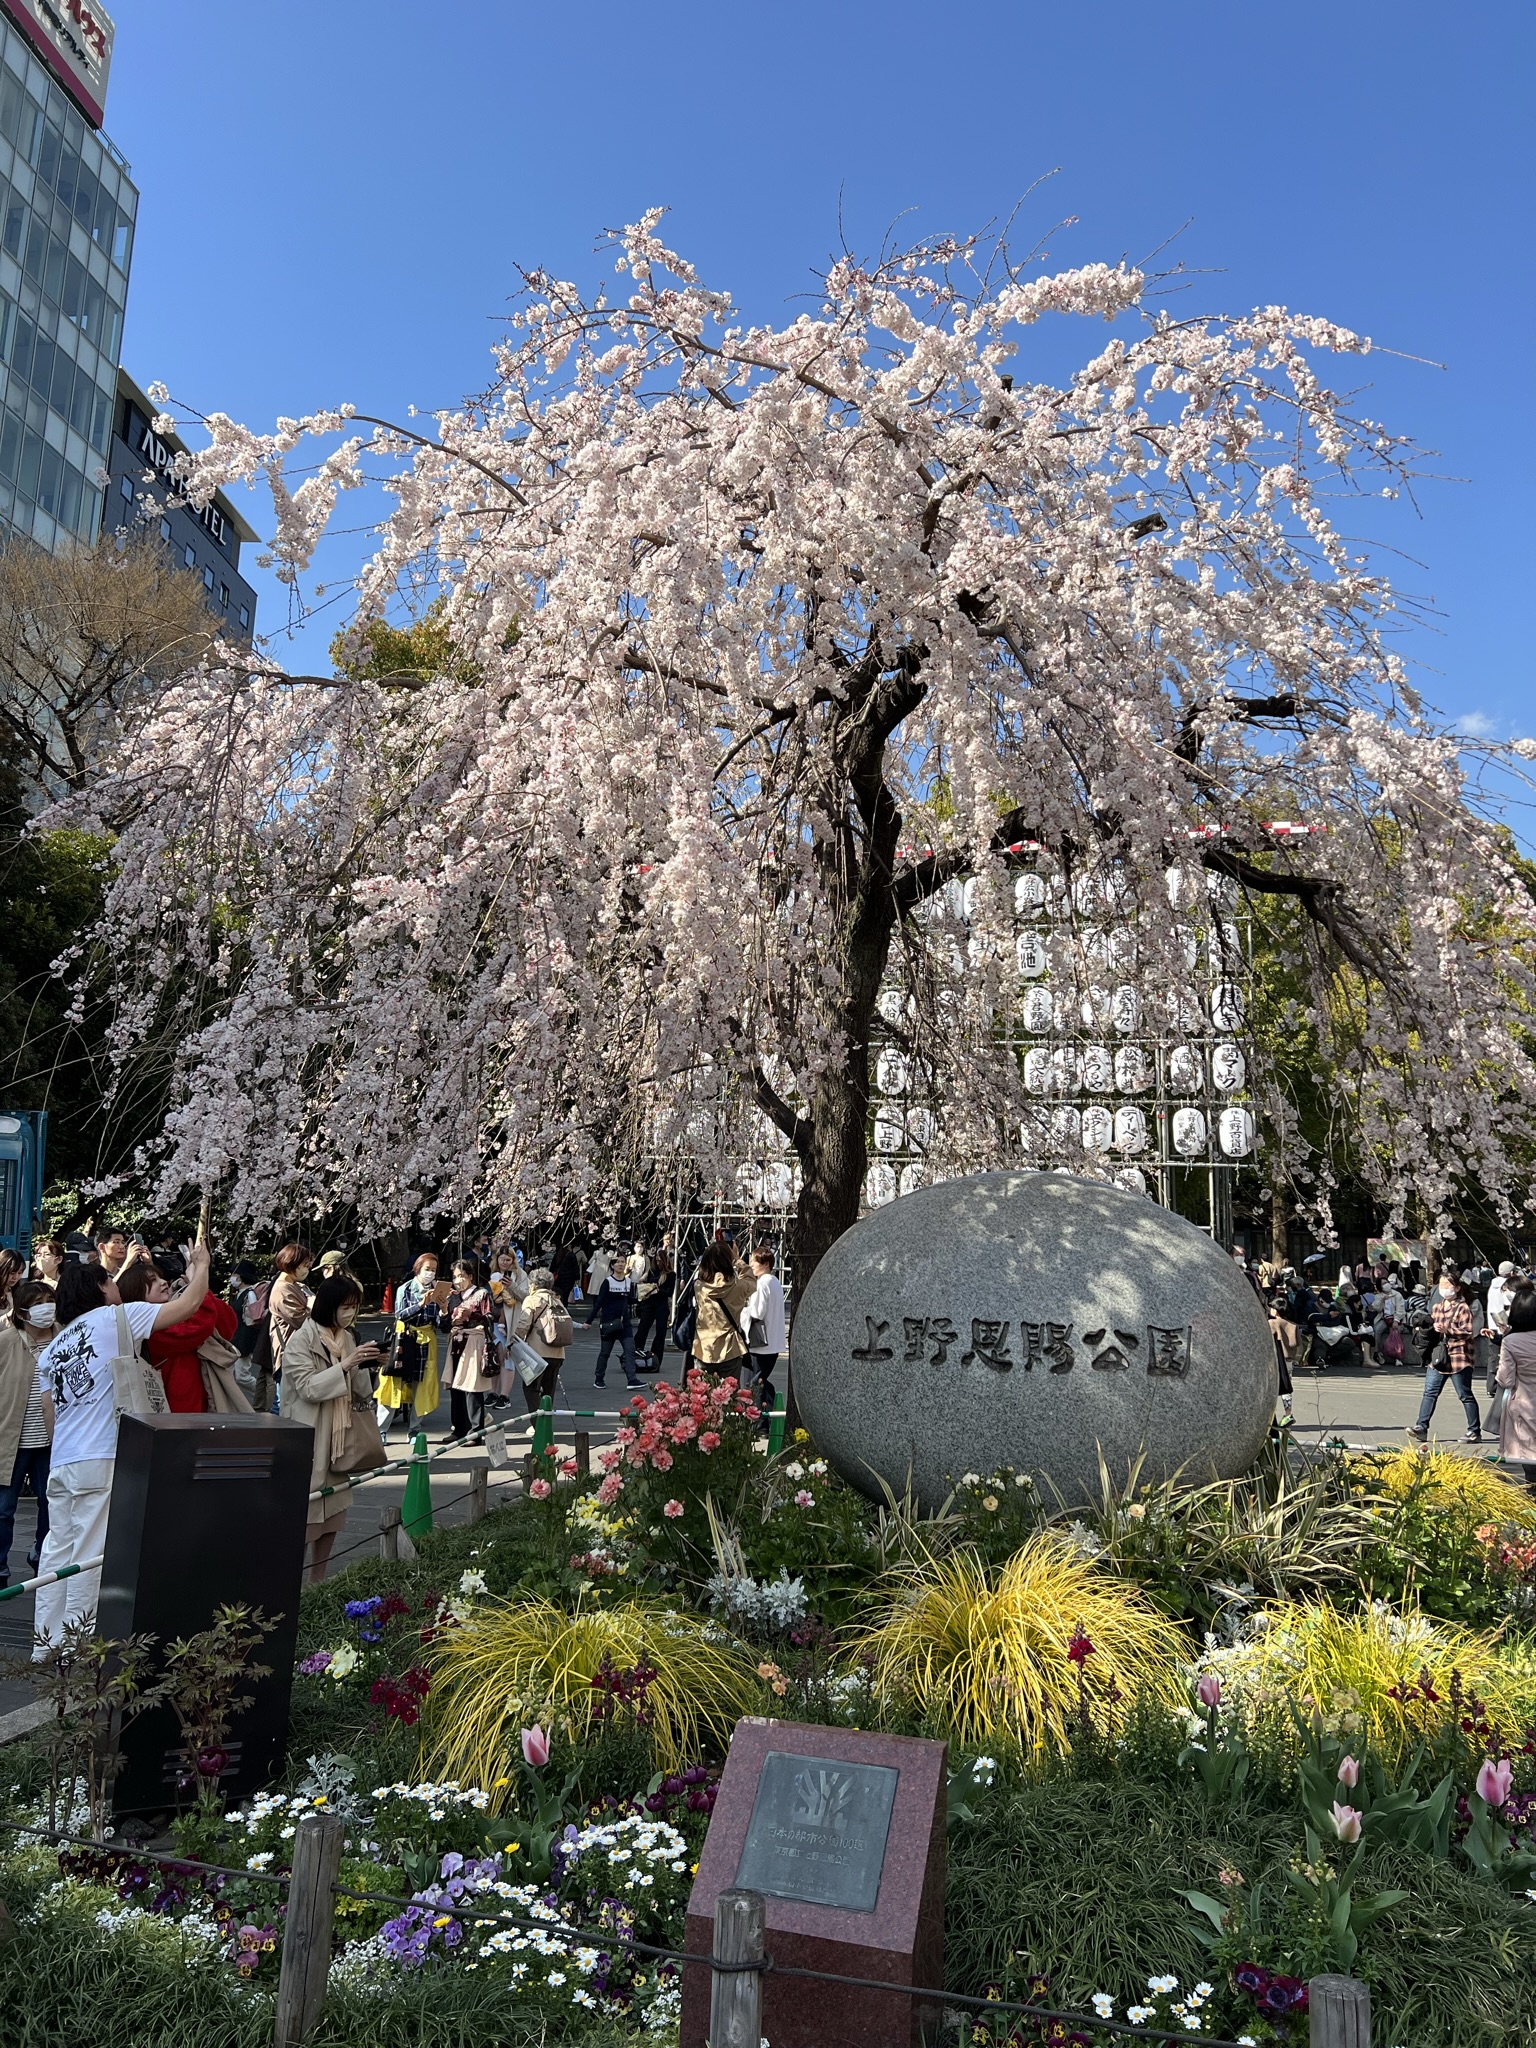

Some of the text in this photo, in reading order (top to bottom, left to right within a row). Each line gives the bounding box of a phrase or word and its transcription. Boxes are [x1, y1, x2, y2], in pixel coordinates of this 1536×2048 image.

[142, 428, 176, 487] APA
[851, 1315, 1194, 1380] 上野恩賜公園
